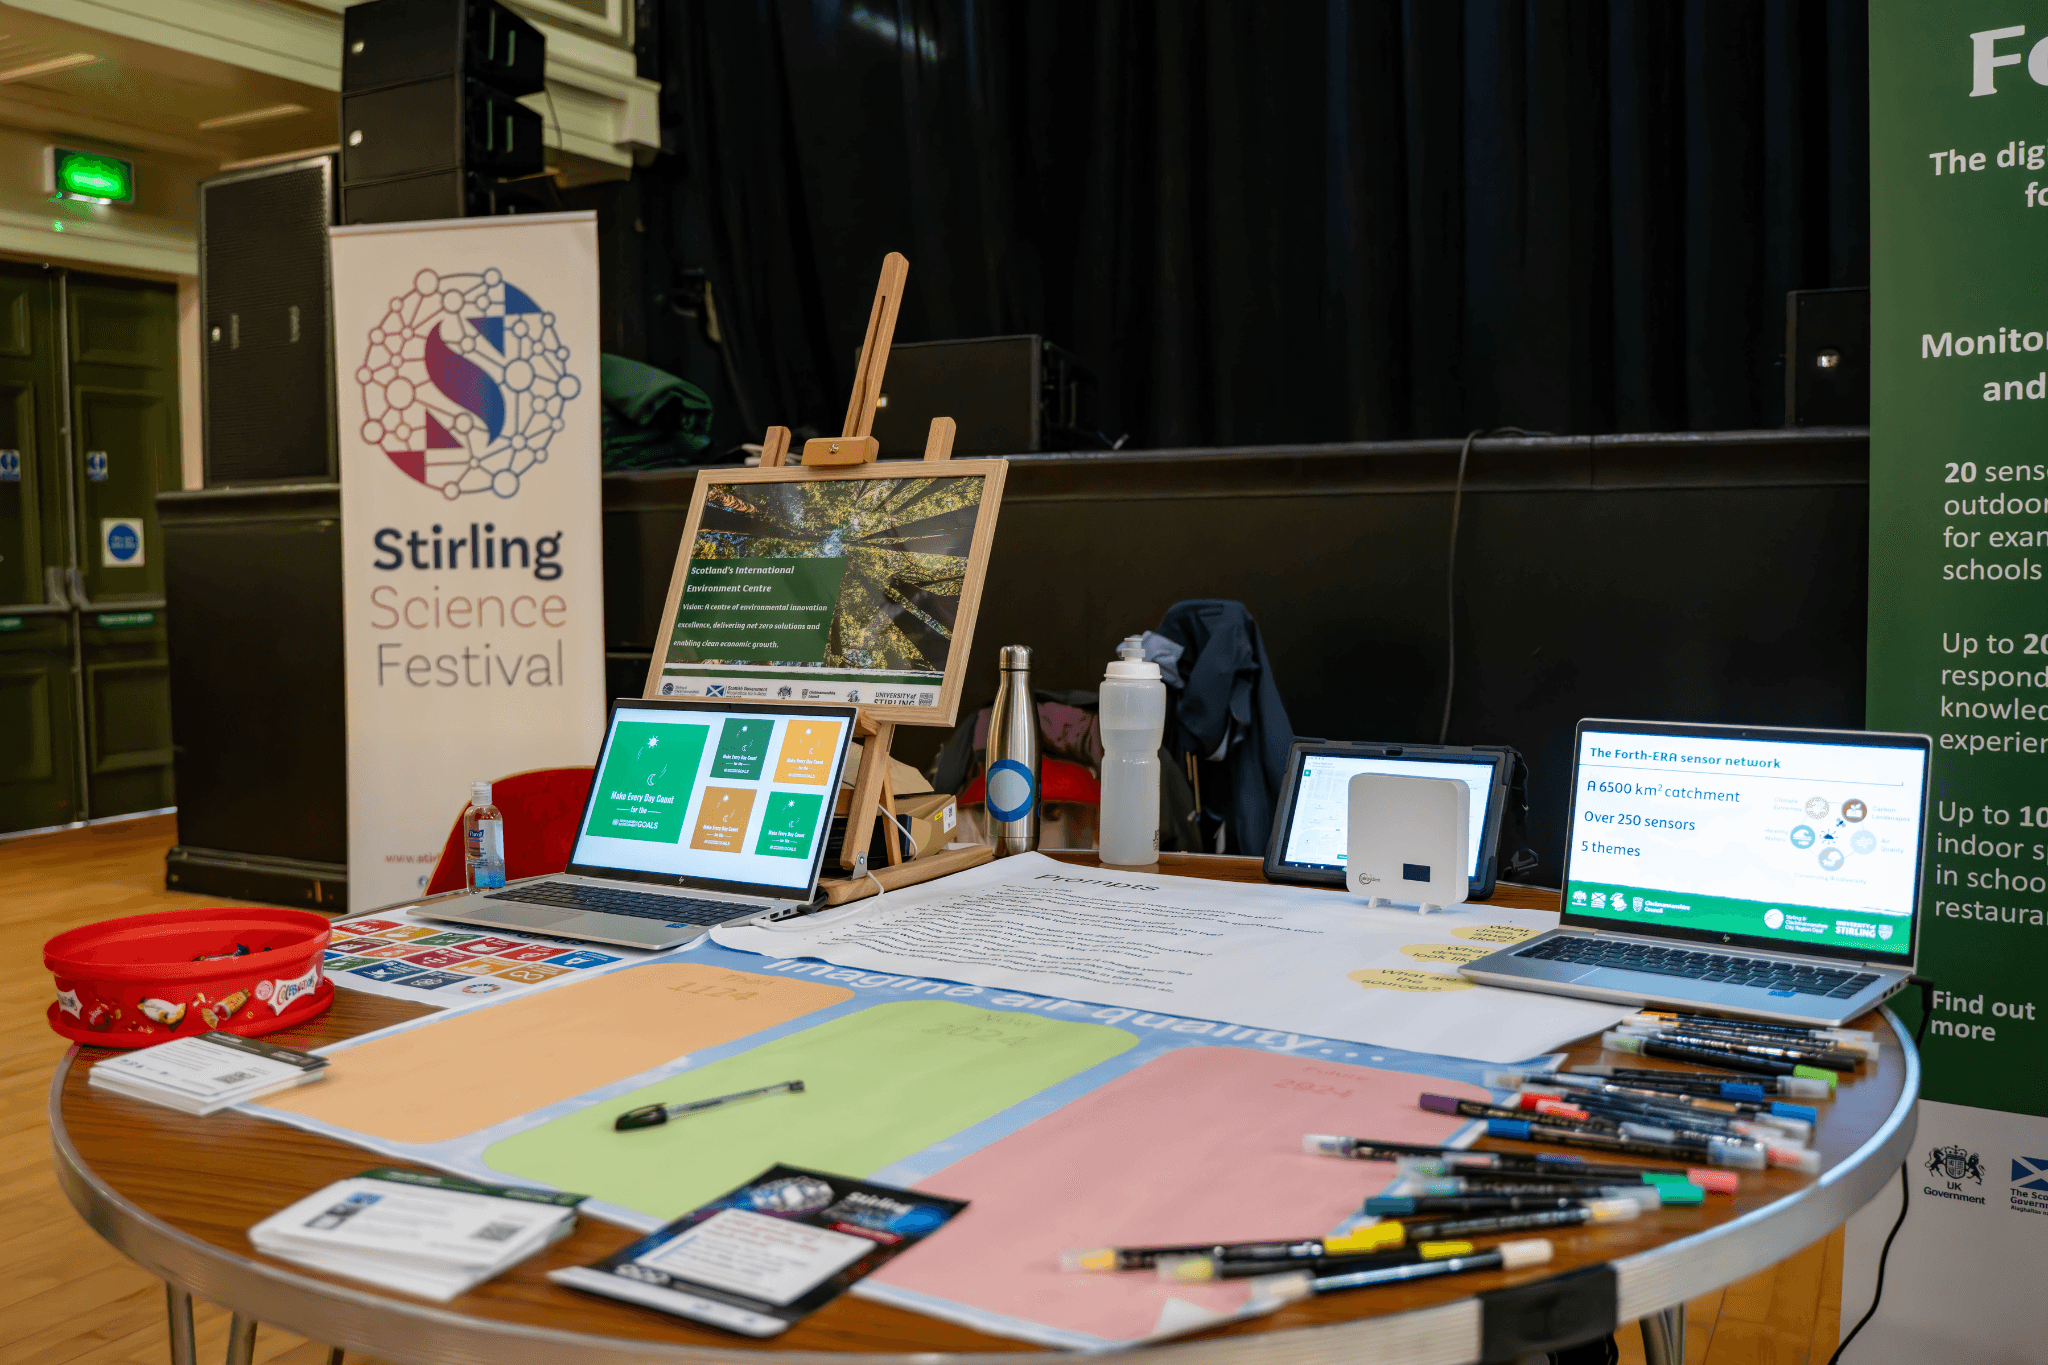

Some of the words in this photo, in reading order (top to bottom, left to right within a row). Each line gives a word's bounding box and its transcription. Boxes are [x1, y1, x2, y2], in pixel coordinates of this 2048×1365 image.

[1929, 149, 1987, 176] The
[1996, 140, 2048, 171] dig
[1921, 326, 2048, 359] Monito
[1982, 371, 2047, 401] and
[1944, 462, 1977, 483] 20
[1985, 464, 2048, 482] sens
[1943, 525, 1981, 548] for
[373, 522, 564, 581] Stirling
[691, 566, 734, 575] Scotland's
[735, 566, 795, 575] International
[1943, 558, 2043, 581] schools
[686, 584, 741, 593] Environment
[742, 584, 772, 593] Centre
[370, 585, 567, 630] Science
[682, 603, 704, 611] Vision:
[731, 603, 739, 611] of
[740, 603, 789, 612] environmental
[790, 604, 828, 612] innovation
[677, 621, 712, 629] excellence,
[712, 622, 745, 631] delivering
[774, 622, 806, 630] solutions
[806, 622, 821, 630] and
[673, 640, 701, 648] enabling
[701, 640, 719, 648] clean
[752, 640, 779, 649] growth.
[1943, 632, 1979, 659] Up
[1987, 635, 2015, 655] to
[377, 639, 564, 687] Festival
[1589, 748, 1612, 758] The
[1614, 749, 1677, 763] Forth-ERA
[1680, 754, 1722, 765] sensor
[1725, 758, 1781, 769] network
[611, 791, 626, 800] Make
[627, 792, 643, 802] Every
[644, 793, 656, 803] Day
[656, 794, 675, 804] Count
[1587, 780, 1596, 792] A
[1599, 781, 1632, 795] 6500
[1664, 787, 1740, 803] catchment
[637, 820, 659, 829] GOALS
[1584, 811, 1615, 824] Over
[1617, 813, 1642, 826] 250
[1644, 816, 1696, 831] sensors
[1938, 801, 1974, 828] Up
[1982, 805, 2010, 826] to
[1581, 840, 1589, 852] 5
[1591, 841, 1641, 857] themes
[1937, 832, 2024, 859] indoor
[1034, 872, 1160, 892] Prompts
[1936, 864, 1958, 886] in
[1489, 925, 1530, 933] What
[1835, 926, 1877, 939] STIRLING
[1447, 946, 1489, 954] What
[1381, 969, 1426, 978] What
[1396, 976, 1424, 984] the
[763, 959, 984, 997] Imagine
[992, 992, 1085, 1012] air
[1932, 990, 1984, 1015] Find
[1992, 1001, 2036, 1021] out
[1931, 1019, 1997, 1042] more
[1923, 1186, 1986, 1205] Government
[1946, 1180, 1963, 1192] UK
[2010, 1187, 2029, 1198] The
